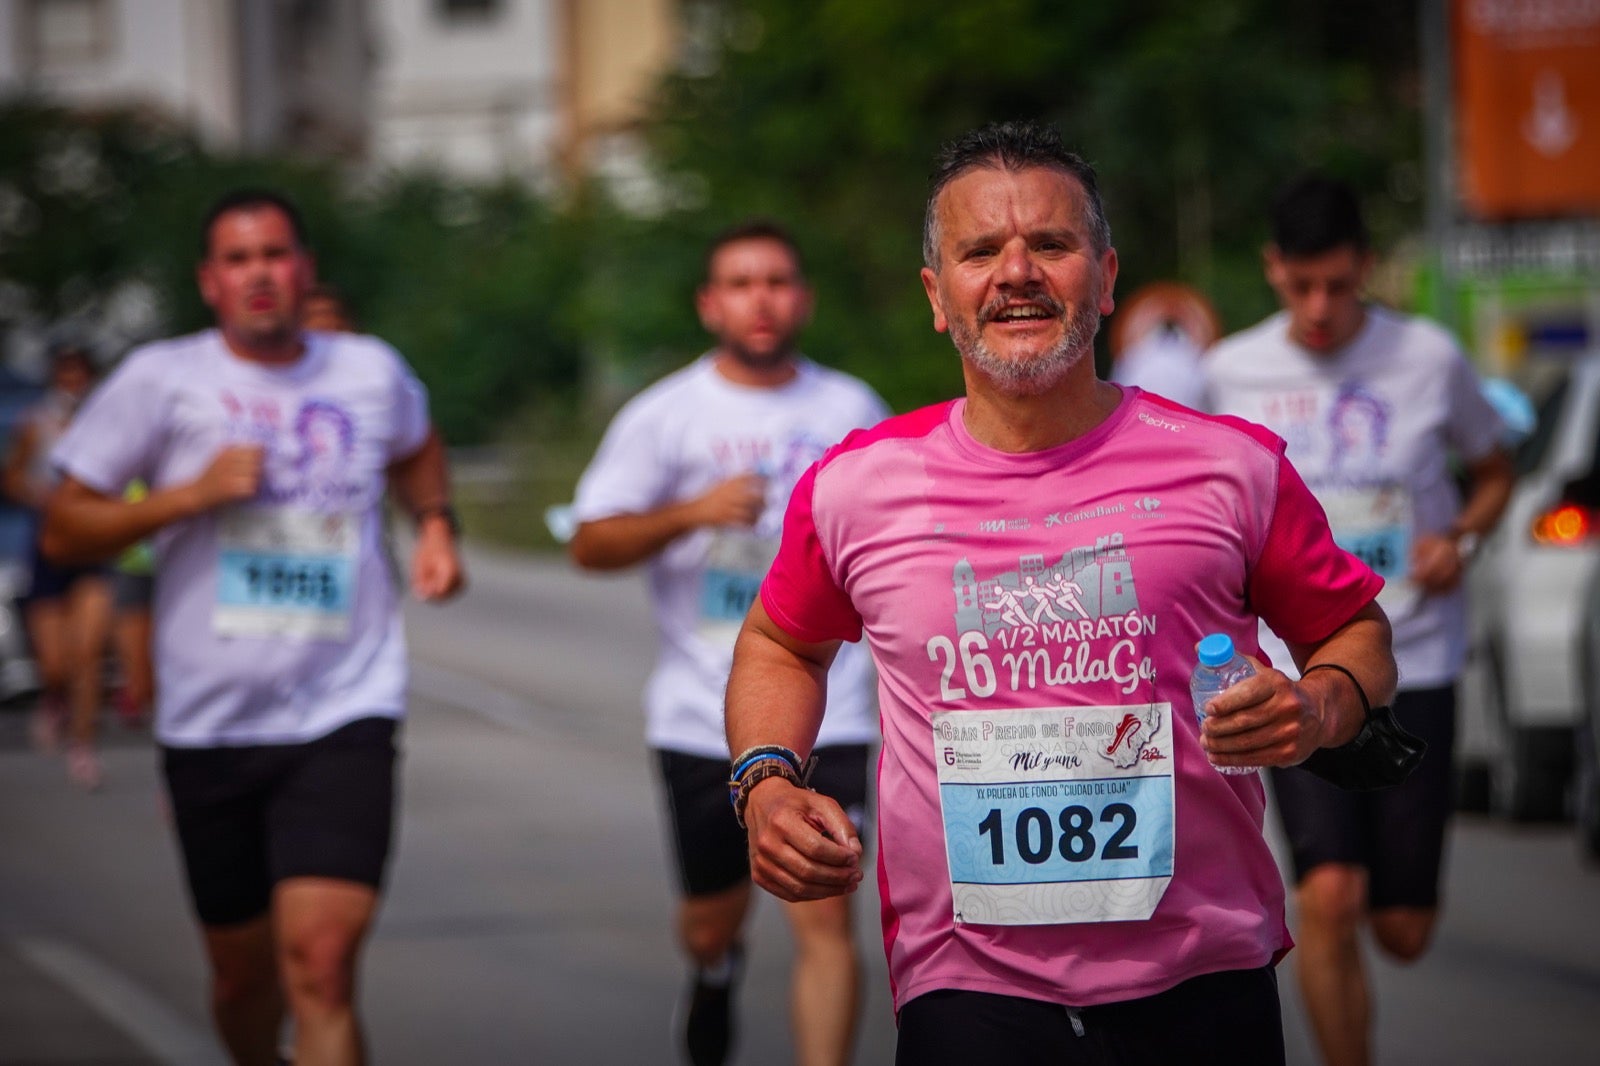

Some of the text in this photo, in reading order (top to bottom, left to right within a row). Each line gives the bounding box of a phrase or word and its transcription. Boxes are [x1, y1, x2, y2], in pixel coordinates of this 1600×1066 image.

[1063, 503, 1126, 524] CaixaBank
[997, 611, 1157, 650] 1/2 MARATÓN
[927, 631, 997, 702] 26
[941, 716, 1115, 741] GRAN PREMIO DE FONDO
[1008, 751, 1043, 771] Mil
[976, 781, 1131, 799] XX PRUEBA DE FONDO "CIUDAD DE LOJA"
[978, 803, 1138, 865] 1082
